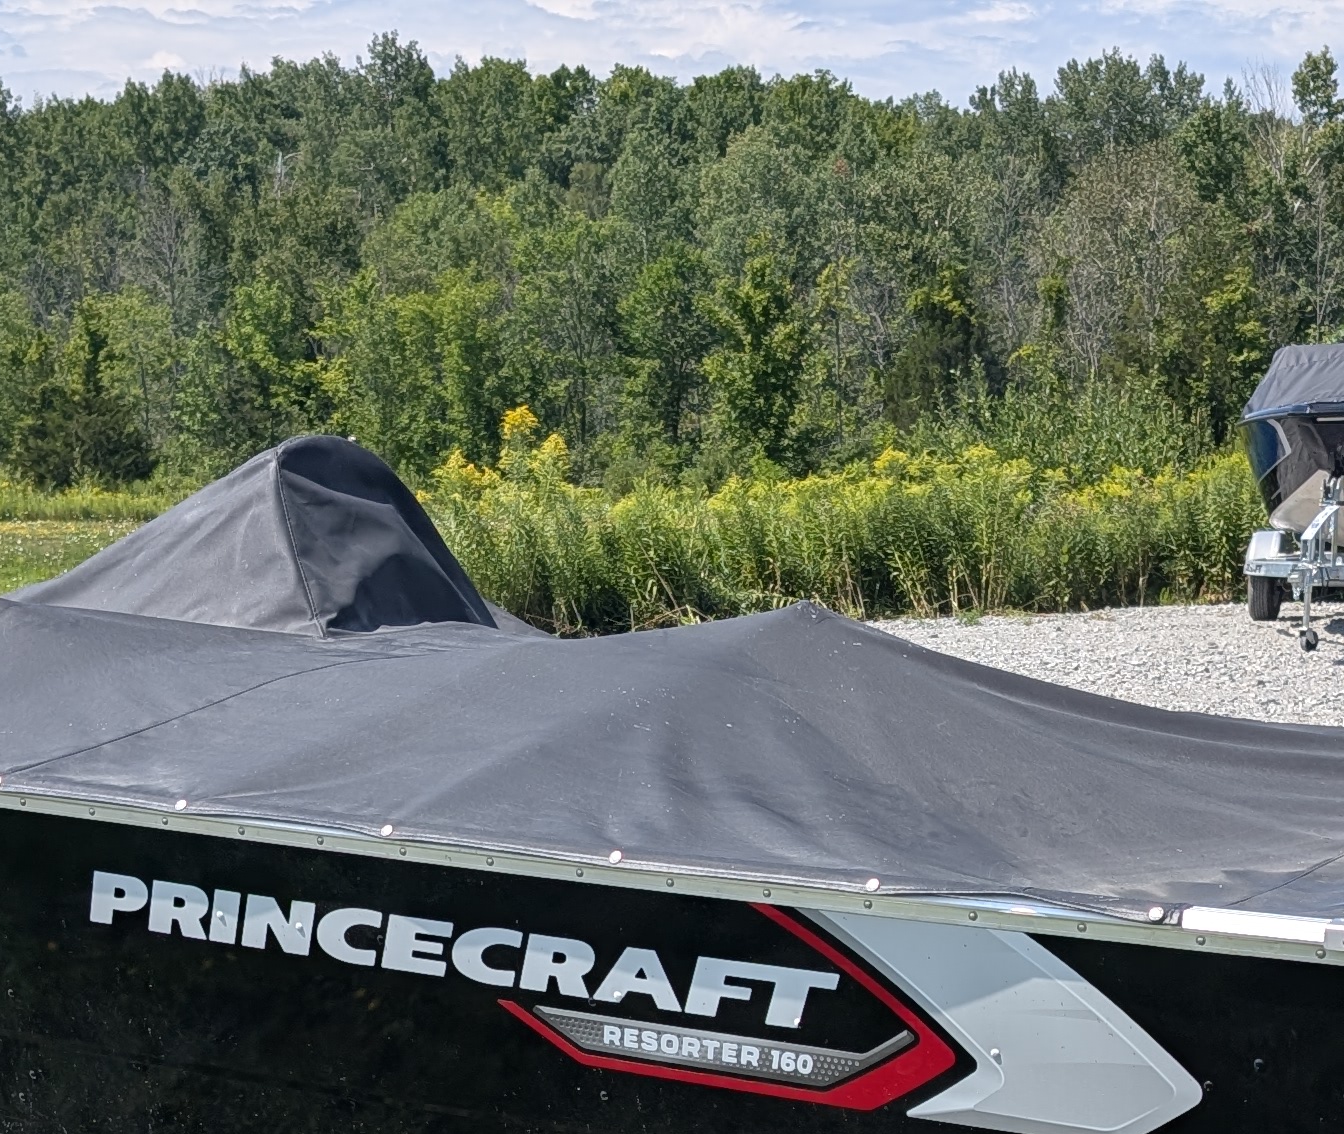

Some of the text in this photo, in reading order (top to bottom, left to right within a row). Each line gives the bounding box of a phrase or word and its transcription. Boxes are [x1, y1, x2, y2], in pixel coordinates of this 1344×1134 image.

[90, 870, 839, 1029] PRINCECRAFT
[603, 1025, 814, 1075] RESORTER 160
